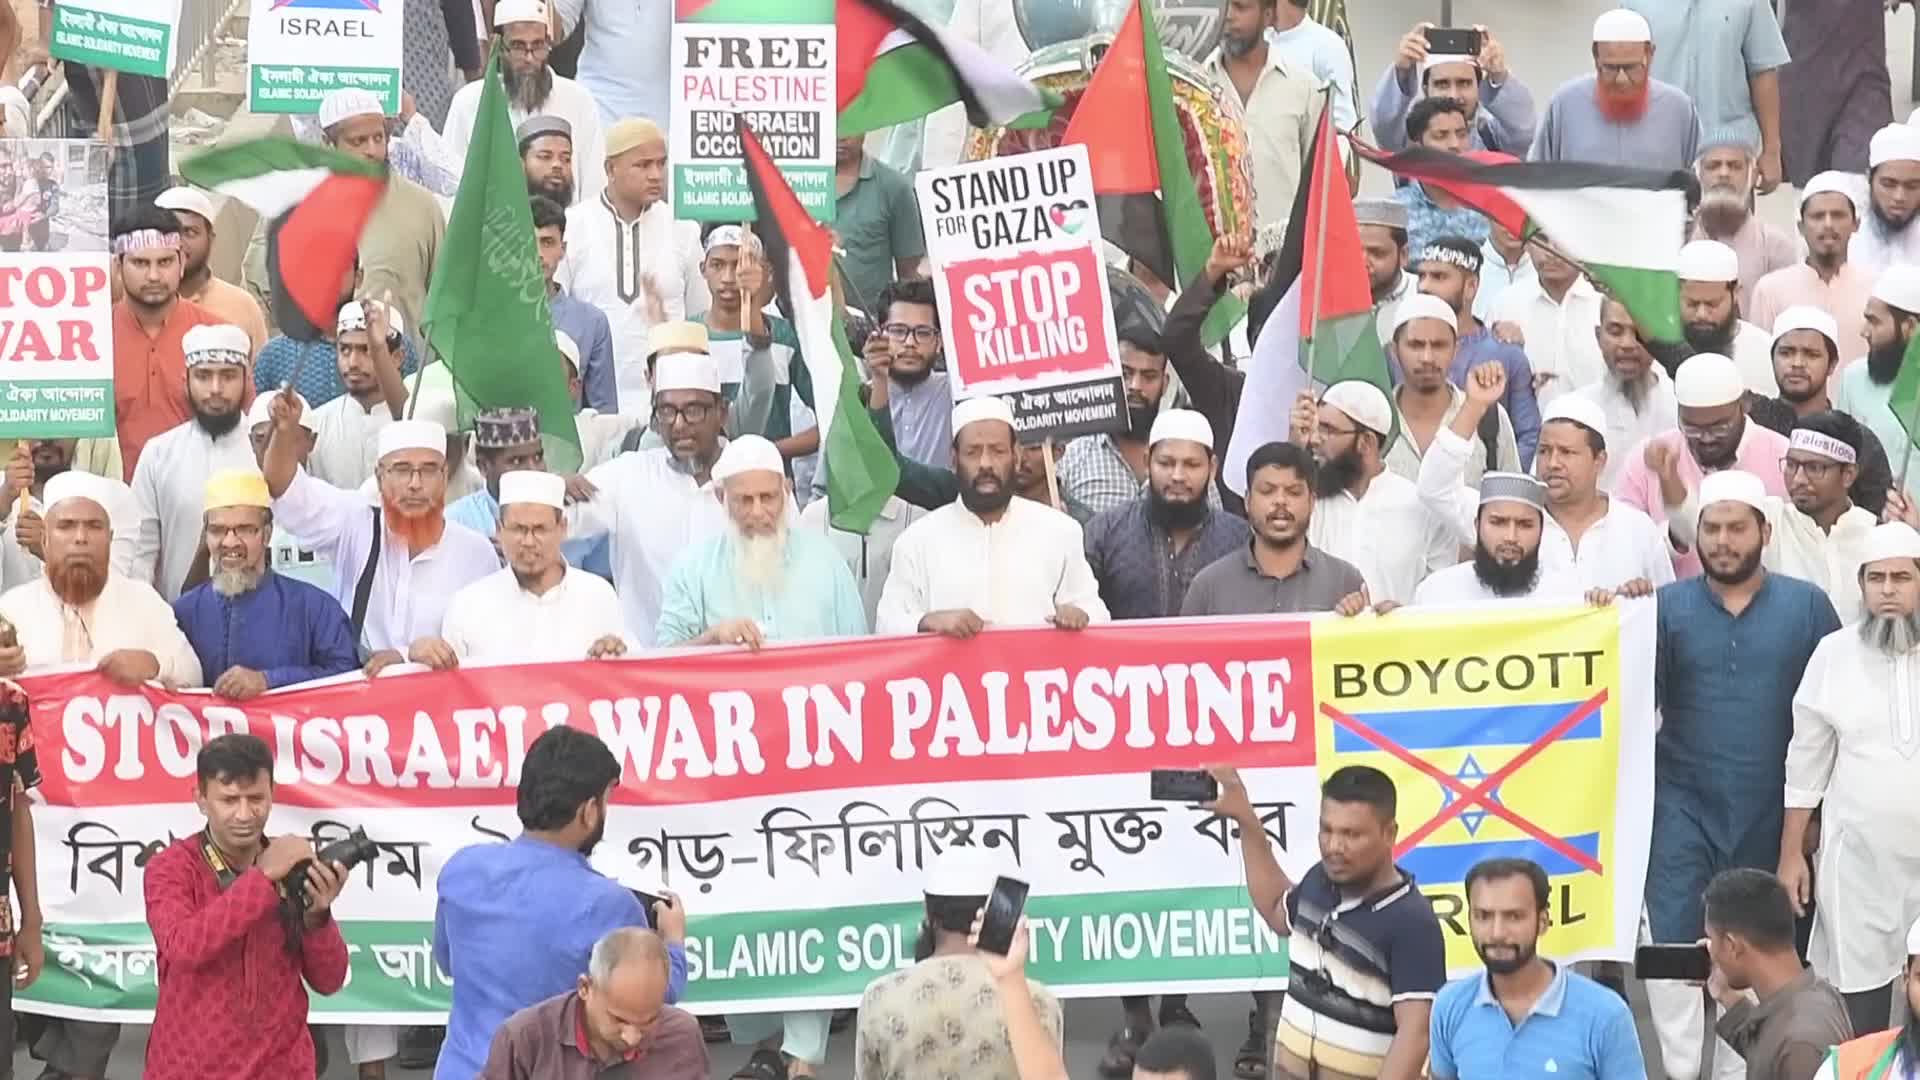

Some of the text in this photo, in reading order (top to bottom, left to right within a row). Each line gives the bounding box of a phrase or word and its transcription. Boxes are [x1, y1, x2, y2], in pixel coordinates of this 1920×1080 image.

[280, 18, 375, 38] ISRAEL
[684, 37, 827, 69] FREE
[683, 75, 827, 102] PALESTINE
[696, 112, 735, 133] END
[696, 135, 814, 157] OCCATION
[932, 158, 1076, 214] STAND UP
[936, 205, 1052, 250] FOR GAZA
[0, 266, 107, 308] TOP
[964, 261, 1081, 332] STOP
[974, 316, 1088, 369] KILLING
[50, 408, 105, 422] MOVEMENT
[1015, 402, 1117, 432] OLIDARITY MOVEMENT
[1333, 650, 1605, 699] BOYCOTT
[270, 703, 570, 790] ISRAEL
[588, 692, 765, 782] WAR
[782, 681, 866, 769] IN
[886, 657, 1297, 760] PALESTINE
[1046, 806, 1168, 878] মুক্ত
[684, 927, 825, 981] SLAMIC
[1081, 907, 1280, 961] MOVEMEN
